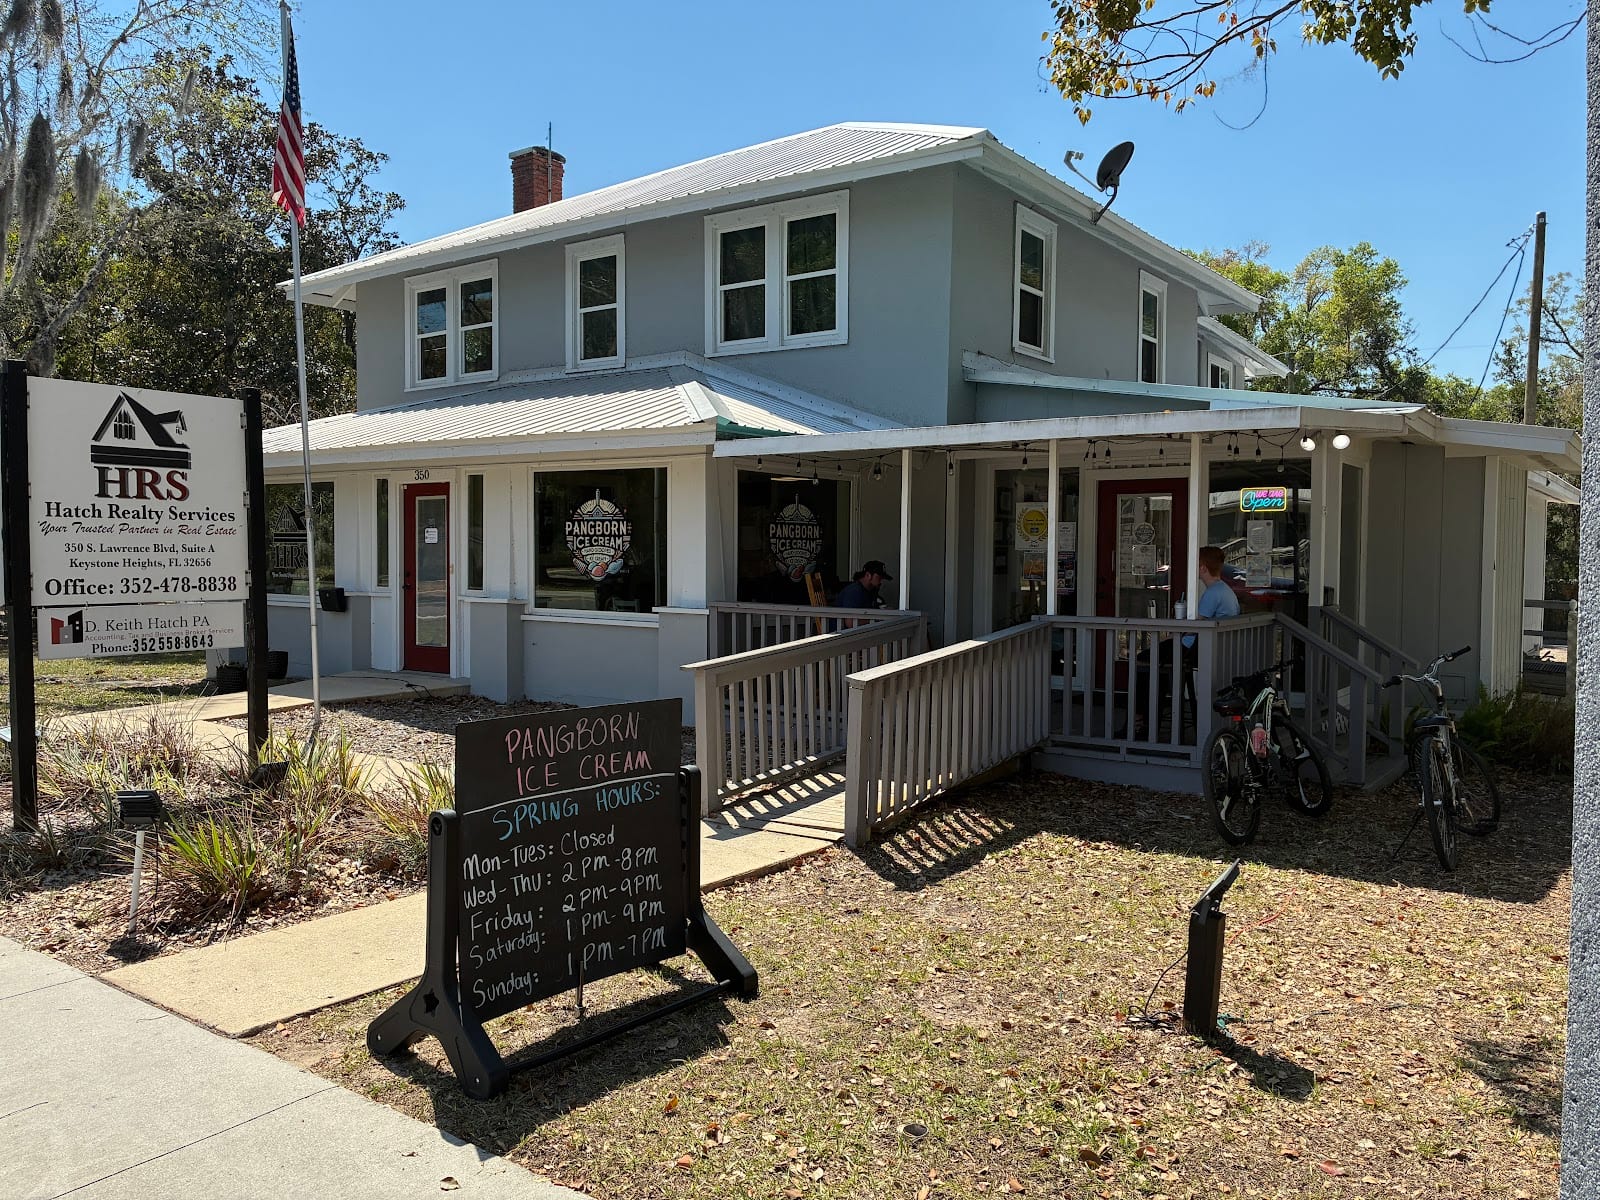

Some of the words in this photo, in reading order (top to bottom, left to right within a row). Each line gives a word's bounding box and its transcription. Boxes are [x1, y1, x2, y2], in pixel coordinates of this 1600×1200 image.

[94, 466, 190, 501] HRS
[414, 469, 430, 481] 350
[1242, 491, 1285, 511] Open
[45, 502, 102, 518] Hatch
[107, 503, 164, 524] Realty
[168, 505, 235, 521] Services
[72, 521, 114, 534] Trusted
[119, 523, 159, 534] Partner
[163, 526, 173, 534] in
[177, 524, 202, 535] Real
[565, 520, 627, 535] PANGBORN
[769, 523, 820, 538] PANGBORN
[64, 542, 83, 553] 350
[86, 542, 96, 553] S.
[99, 543, 150, 553] Lawrence
[153, 543, 179, 554] Blvd,
[181, 543, 206, 553] Suite
[208, 544, 215, 553] A
[573, 536, 590, 550] ICE
[591, 536, 623, 551] CREAM
[776, 539, 791, 553] ICE
[792, 539, 816, 553] CREAM
[69, 558, 119, 570] Keystone
[122, 558, 166, 570] Heights,
[168, 558, 181, 567] FL
[183, 558, 212, 567] 32656
[45, 578, 114, 596] Office:
[120, 576, 237, 595] 352-478-8838
[84, 620, 100, 633] D.
[105, 618, 143, 631] Keith
[148, 616, 188, 630] Hatch
[192, 615, 210, 627] PA
[208, 627, 234, 635] Services
[92, 643, 132, 654] Phone:
[505, 711, 640, 764] PANGBORN
[516, 762, 559, 796] ICE
[579, 751, 653, 780] CREAM
[492, 798, 579, 841] SPRING
[596, 781, 661, 812] HOURS:
[561, 824, 615, 855] Closed
[469, 931, 546, 969] Saturday:
[472, 971, 539, 1009] Sunday:
